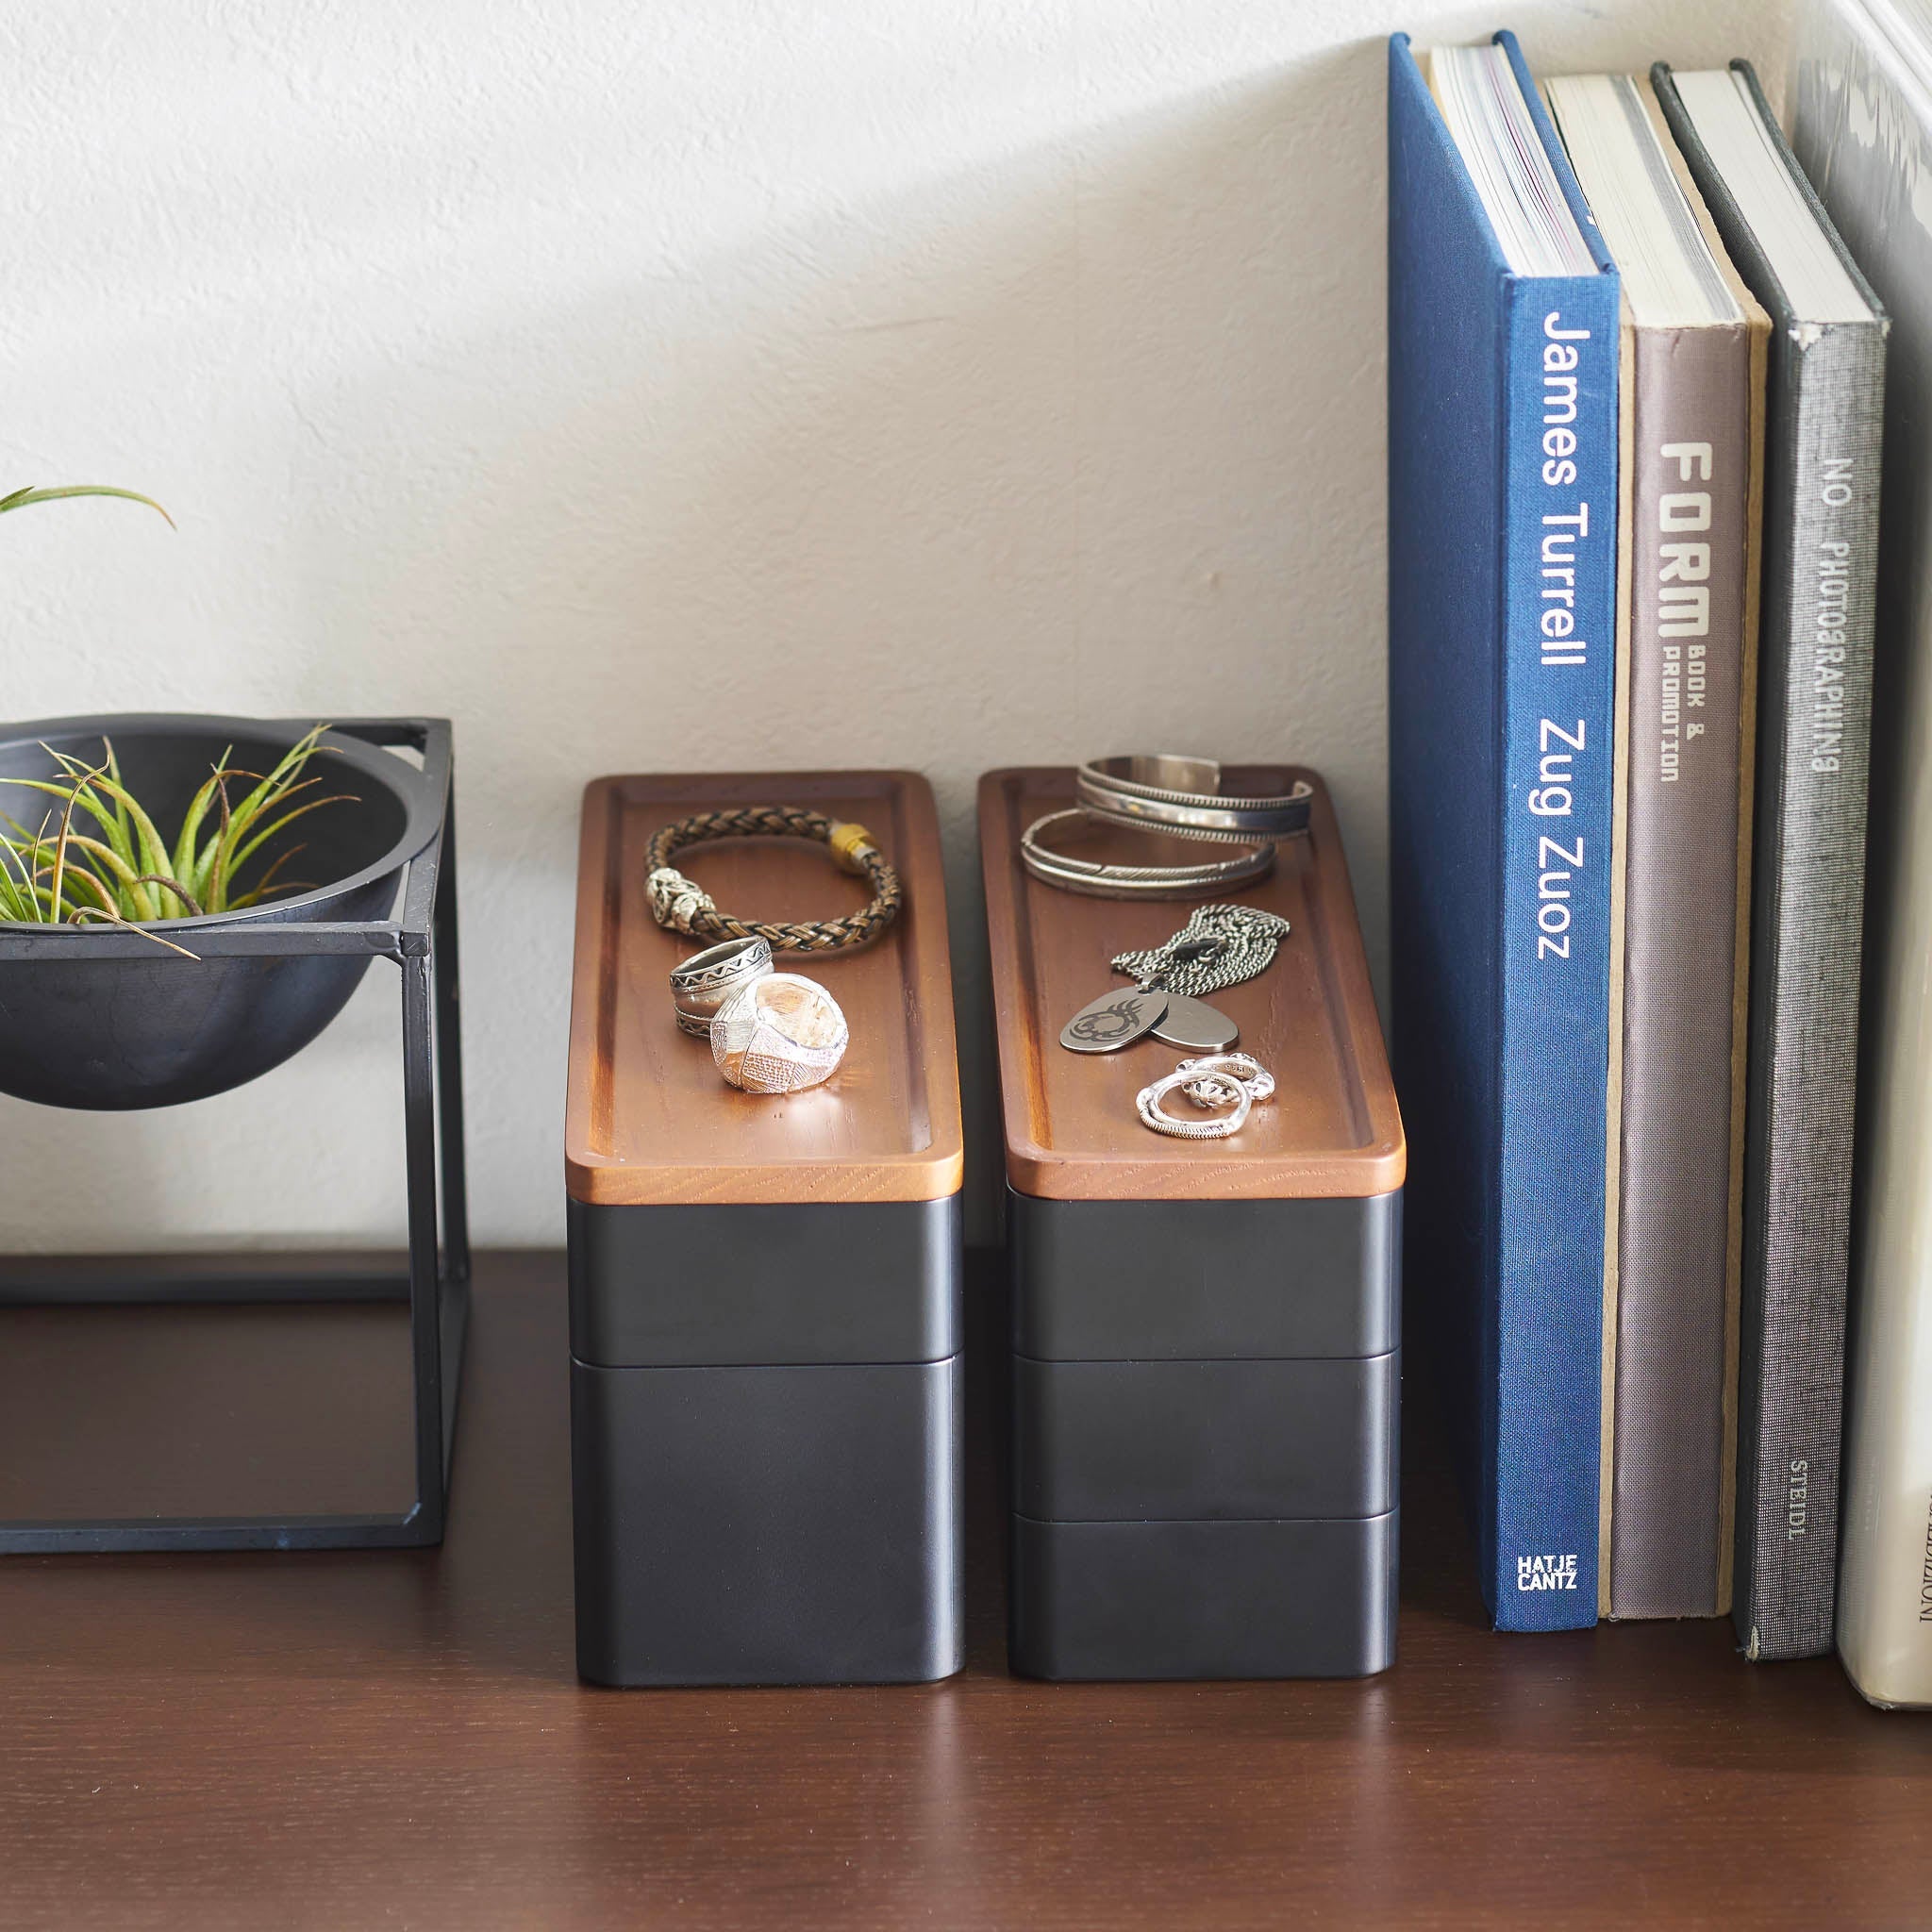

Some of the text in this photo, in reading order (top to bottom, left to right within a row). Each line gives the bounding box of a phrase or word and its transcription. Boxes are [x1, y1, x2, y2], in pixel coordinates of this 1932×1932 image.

[1822, 458, 1853, 508] NO
[1657, 441, 1713, 638] FORM
[1528, 311, 1591, 959] James Turrell Zug Zuoz
[1686, 644, 1706, 741] BOOK &
[1788, 1459, 1808, 1541] STEIDL
[1517, 1554, 1578, 1574] HATJE
[1517, 1573, 1577, 1591] CANTZ
